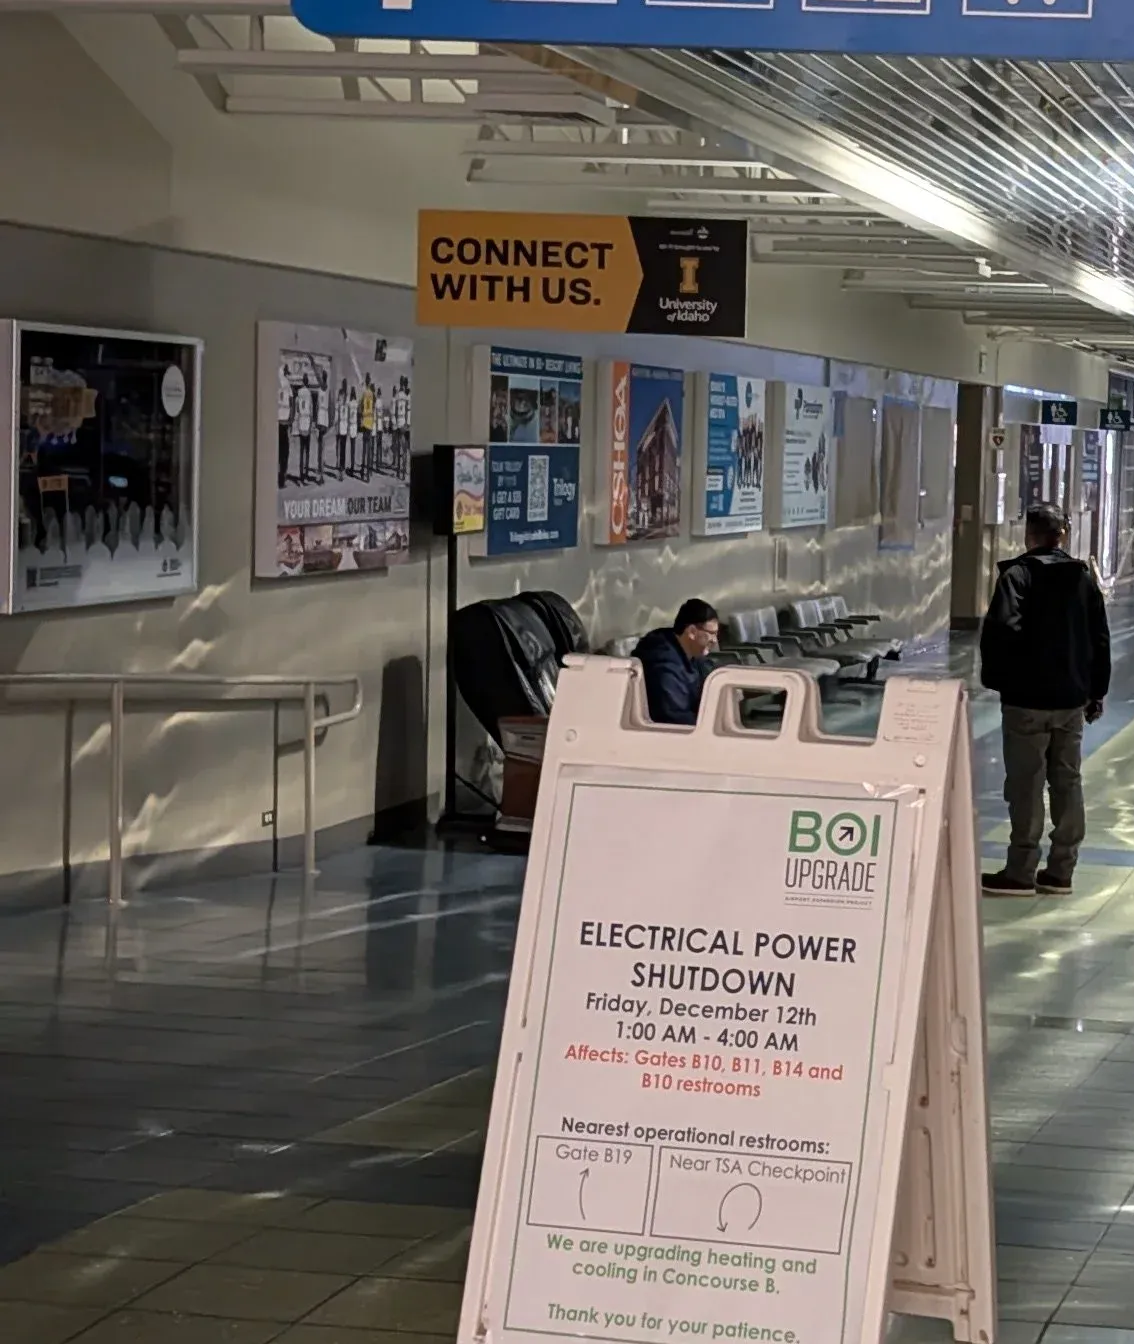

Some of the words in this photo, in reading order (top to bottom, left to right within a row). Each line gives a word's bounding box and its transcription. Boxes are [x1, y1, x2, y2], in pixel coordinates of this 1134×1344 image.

[430, 236, 614, 270] CONNECT
[430, 273, 531, 303] WITH
[542, 277, 602, 306] US.
[659, 297, 718, 314] University
[666, 312, 678, 323] of
[676, 308, 710, 323] Idaho
[552, 478, 577, 502] Trilogy
[283, 499, 310, 520] YOUR
[312, 497, 347, 517] DREAM
[347, 496, 366, 515] OUR
[367, 495, 392, 514] TEAM
[788, 810, 881, 857] BOI
[785, 858, 877, 892] UPGRADE
[580, 921, 744, 956] ELECTRICAL
[754, 932, 857, 963] POWER
[630, 962, 796, 998] SHUTDOWN
[586, 992, 653, 1017] Friday,
[659, 998, 768, 1024] December
[775, 1006, 817, 1026] 12th
[615, 1021, 656, 1042] 1:00
[661, 1025, 697, 1044] AM
[716, 1029, 759, 1049] 4:00
[764, 1032, 798, 1052] AM
[564, 1044, 629, 1065] Affects:
[634, 1049, 687, 1070] Gates
[691, 1054, 726, 1074] B10,
[731, 1058, 766, 1076] B11,
[772, 1060, 804, 1078] B14
[808, 1064, 844, 1081] and
[641, 1072, 673, 1091] B10
[676, 1076, 762, 1098] restrooms
[560, 1116, 630, 1140] Nearest
[633, 1124, 735, 1147] operational
[738, 1131, 831, 1155] restrooms:
[555, 1143, 600, 1163] Gate
[603, 1147, 633, 1165] B19
[669, 1154, 712, 1172] Near
[714, 1157, 743, 1176] TSA
[747, 1160, 847, 1185] Checkpoint
[547, 1233, 574, 1252] We
[579, 1238, 609, 1255] are
[613, 1241, 703, 1267] upgrading
[706, 1247, 777, 1274] heating
[781, 1256, 817, 1275] and
[572, 1262, 638, 1286] cooling
[642, 1266, 658, 1283] in
[661, 1267, 760, 1293] Concourse
[764, 1278, 781, 1295] B.
[548, 1303, 599, 1325] Thank
[603, 1311, 636, 1330] you
[640, 1312, 663, 1331] for
[667, 1318, 709, 1337] your
[711, 1321, 801, 1344] patience.
